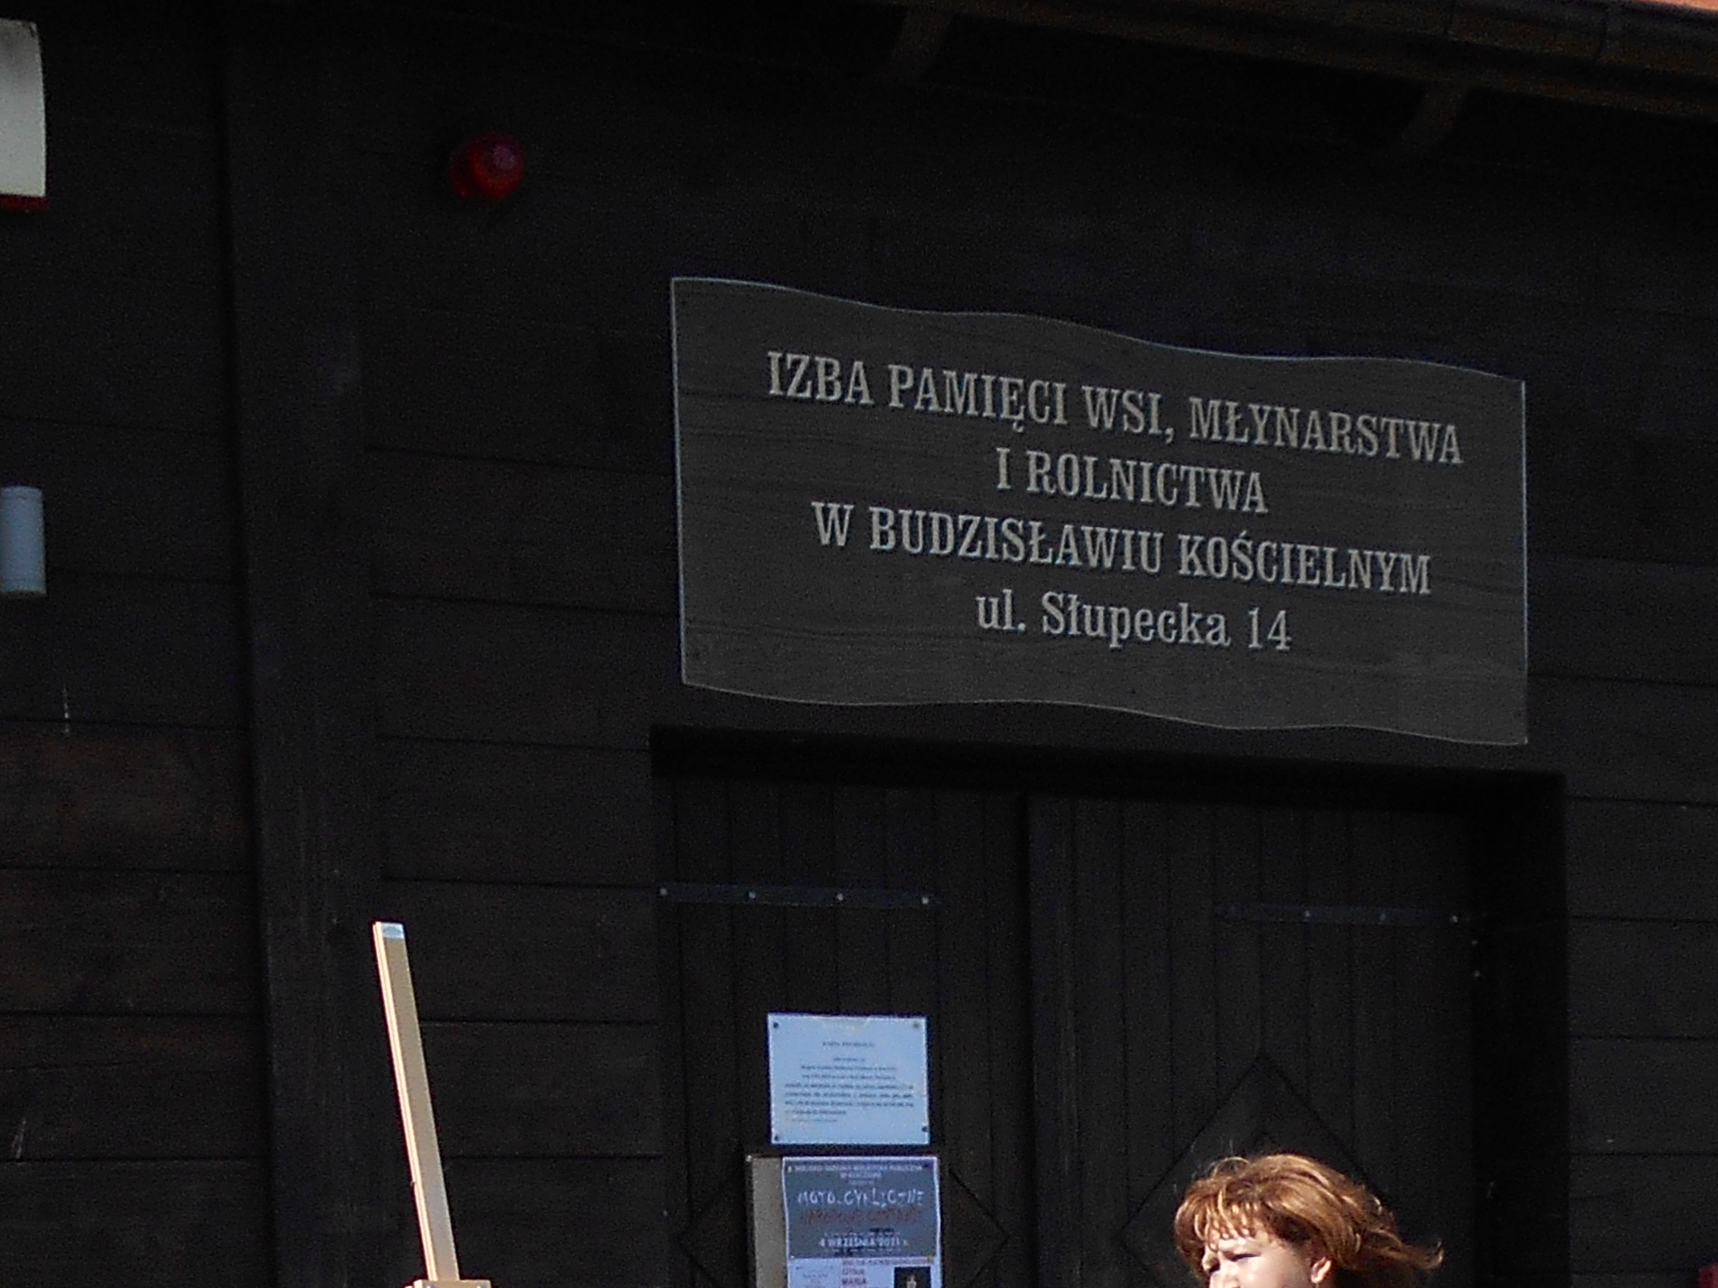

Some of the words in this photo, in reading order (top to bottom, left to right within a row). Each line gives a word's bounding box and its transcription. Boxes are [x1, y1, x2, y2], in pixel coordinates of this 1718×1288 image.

[767, 351, 875, 405] IZBA
[887, 362, 1069, 433] PAMIĘCI
[1081, 384, 1175, 443] WSI,
[1188, 396, 1463, 466] MŁYNARSTWA
[995, 446, 1011, 490] I
[1025, 450, 1270, 516] ROLNICTWA
[811, 502, 853, 548] W
[869, 505, 1164, 575] BUDZISŁAWIU
[1178, 530, 1432, 596] KOŚCIELNYM
[975, 590, 1027, 635] ul.
[1041, 589, 1231, 651] Słupecka
[1246, 605, 1293, 652] 14
